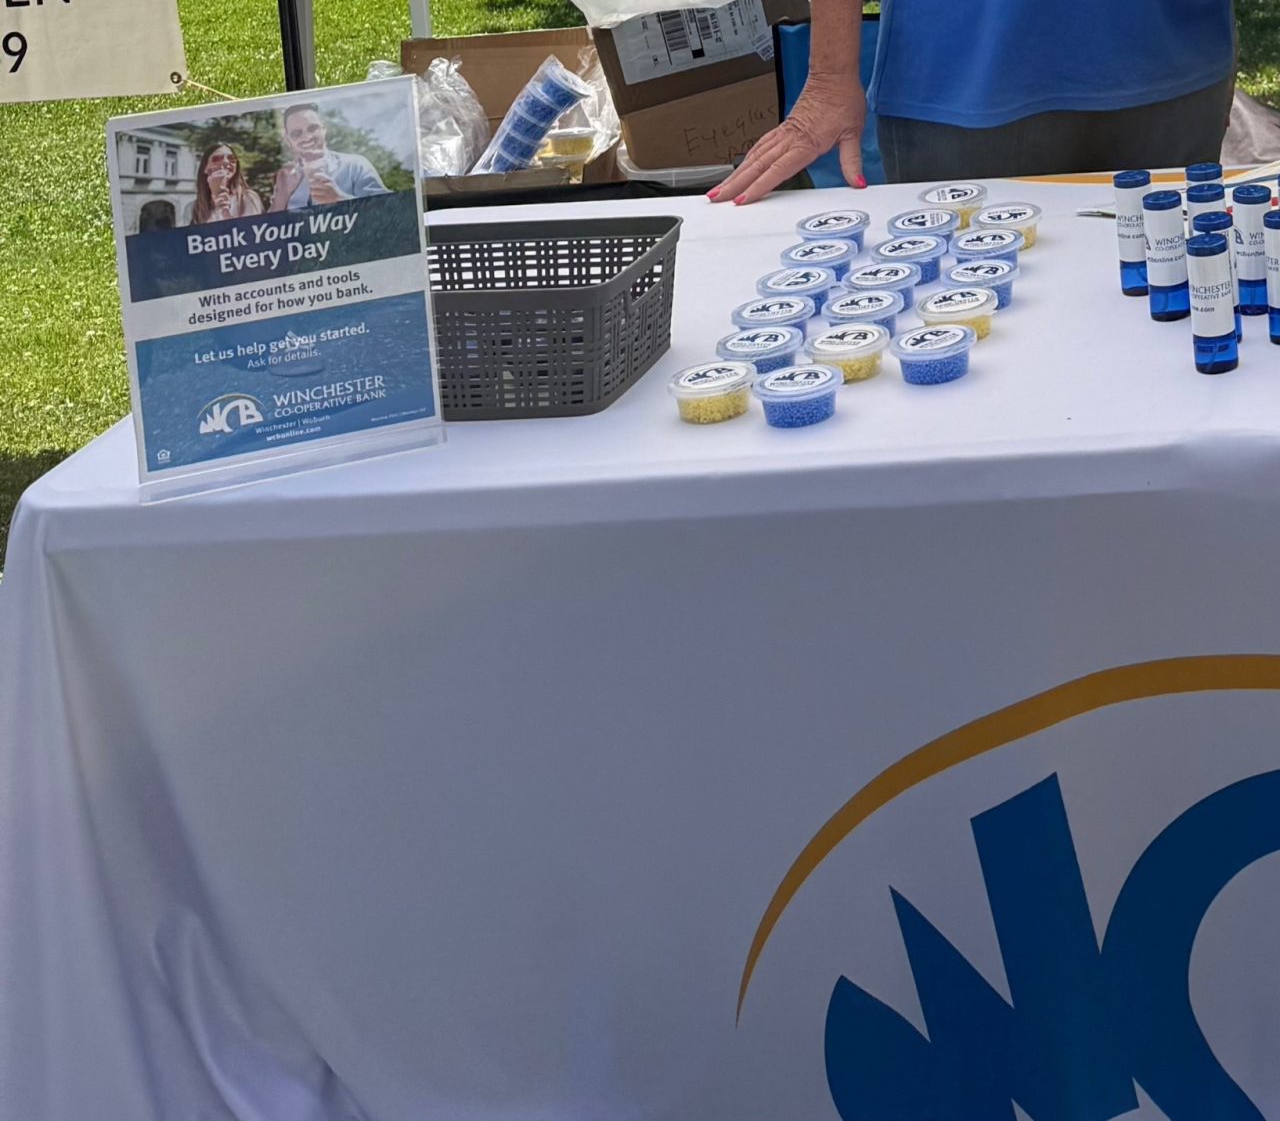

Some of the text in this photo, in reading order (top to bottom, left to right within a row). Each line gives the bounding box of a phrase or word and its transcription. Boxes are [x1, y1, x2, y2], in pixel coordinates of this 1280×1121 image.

[187, 212, 358, 255] Bank Your Way
[220, 241, 330, 273] Every Day
[188, 283, 373, 325] designed for how you bank.
[199, 270, 360, 308] With accounts and tools
[194, 322, 370, 364] Let us help get you started.
[247, 348, 322, 369] Ask for details.
[273, 375, 385, 406] WINCHESTER
[274, 396, 353, 418] CO-OPERATIVE
[356, 388, 386, 403] BANK
[255, 414, 330, 434] Winchester Woburn
[266, 426, 321, 442] wcbonline.com
